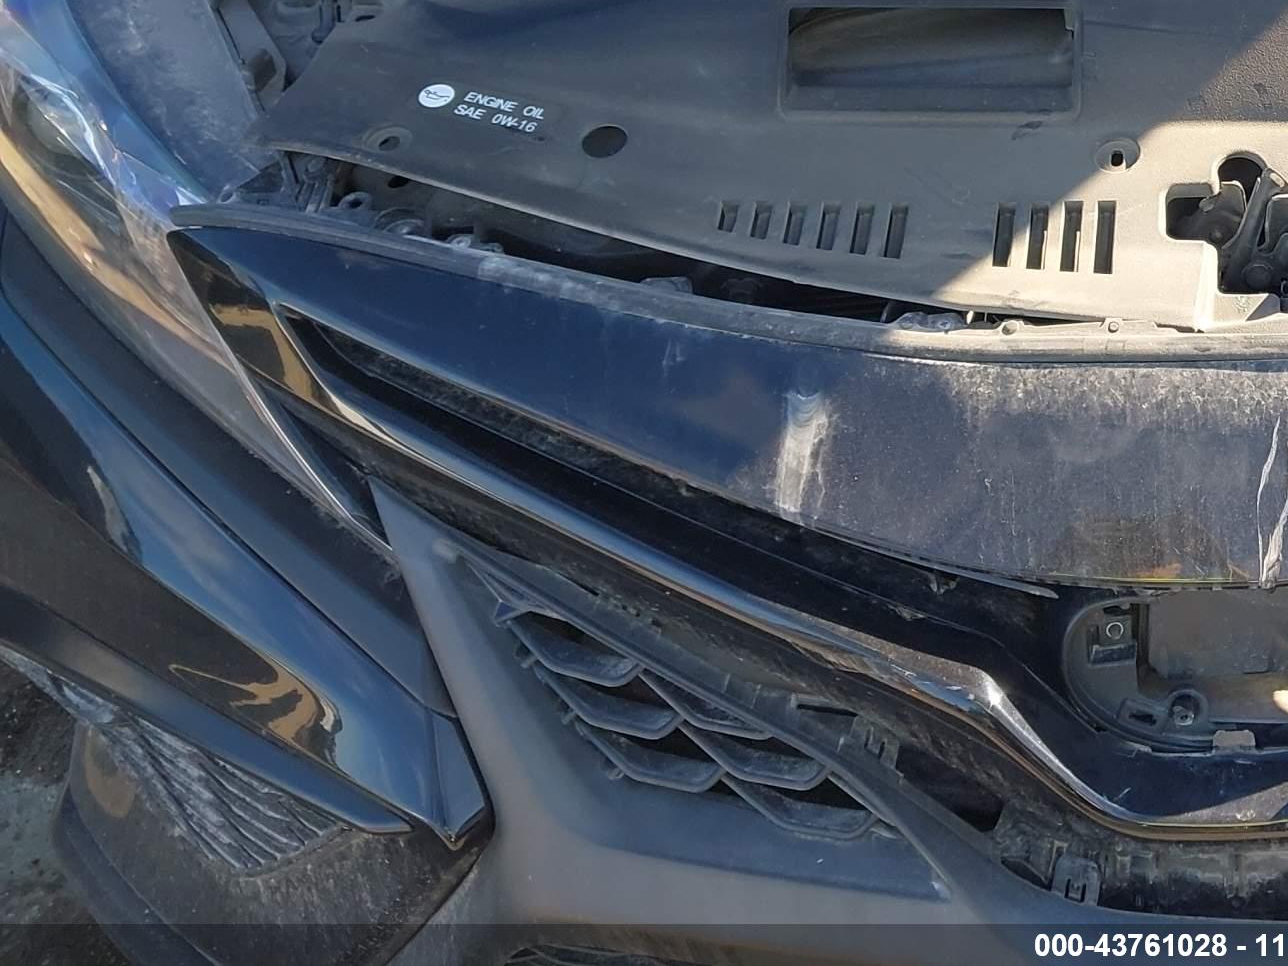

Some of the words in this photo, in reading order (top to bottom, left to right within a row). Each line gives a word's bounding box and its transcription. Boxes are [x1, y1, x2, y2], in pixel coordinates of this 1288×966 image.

[453, 104, 487, 120] SAE
[491, 113, 538, 133] 0W-16
[463, 91, 519, 112] ENGINE
[522, 105, 545, 120] OIL
